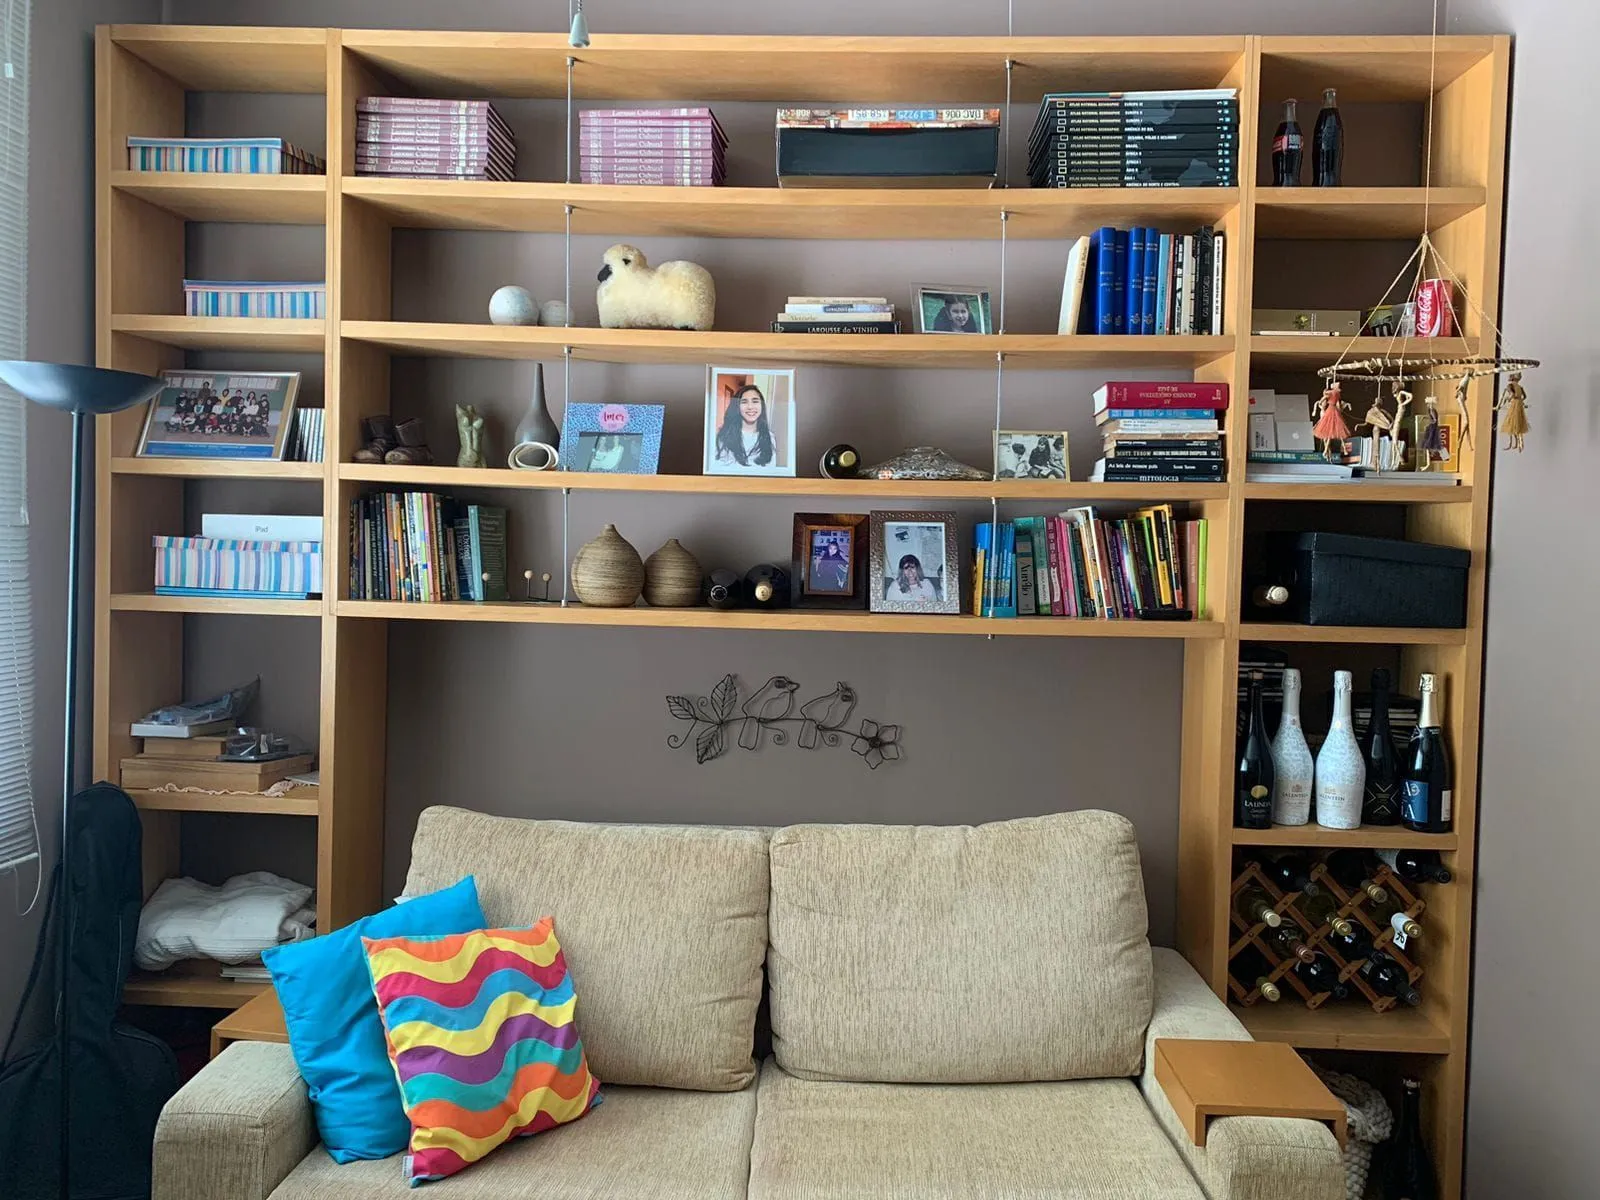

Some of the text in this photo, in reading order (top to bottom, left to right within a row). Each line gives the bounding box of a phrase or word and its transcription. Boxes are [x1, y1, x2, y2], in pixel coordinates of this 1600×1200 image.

[853, 326, 879, 334] VINHO
[255, 525, 269, 533] iPad
[463, 534, 471, 560] Oxford
